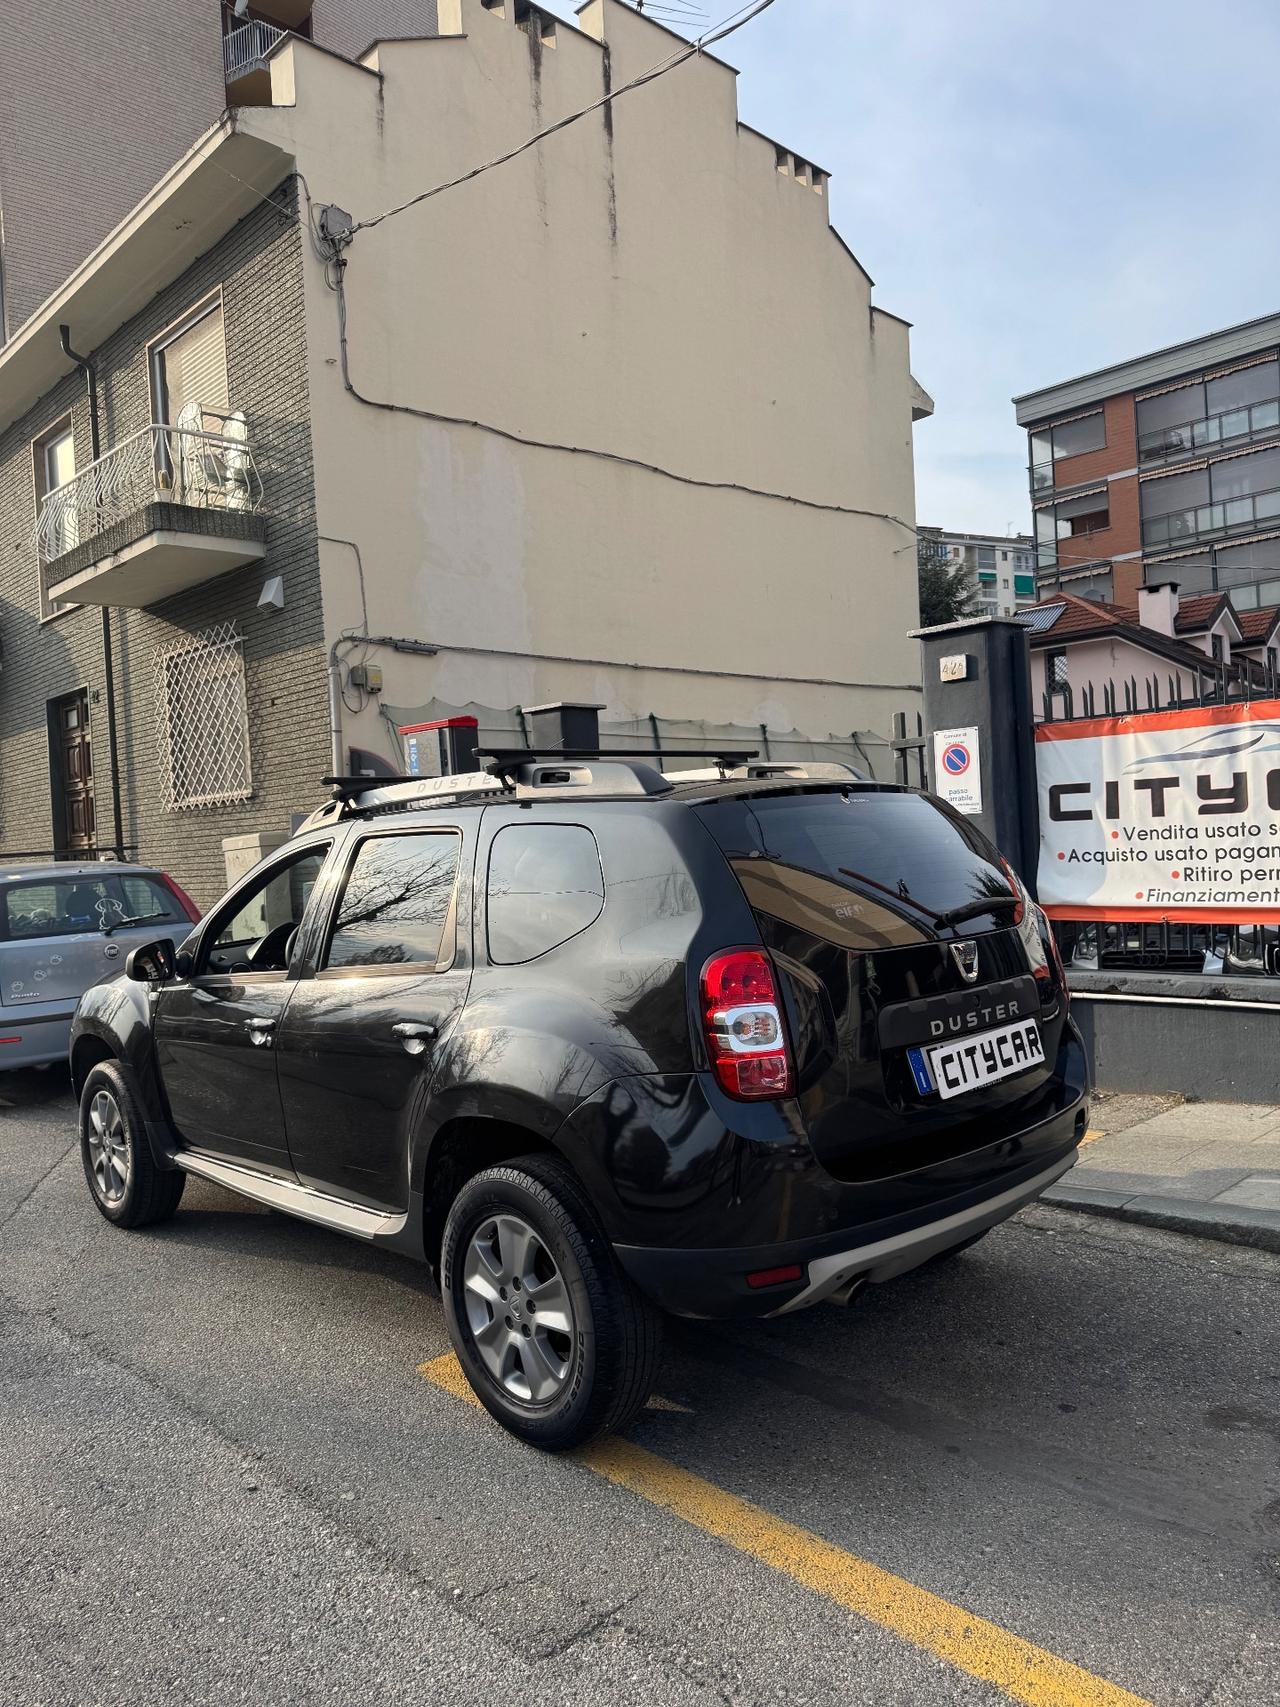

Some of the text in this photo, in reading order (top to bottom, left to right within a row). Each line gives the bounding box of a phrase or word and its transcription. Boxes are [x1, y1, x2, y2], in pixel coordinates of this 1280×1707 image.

[417, 775, 491, 794] DUSTE
[1123, 821, 1280, 841] Vendita usato s
[1067, 847, 1148, 866] Acquisto
[1155, 845, 1208, 861] usato
[1183, 866, 1233, 882] Ritiro
[929, 1000, 1020, 1036] DUSTER
[940, 1025, 1042, 1089] CITYCAR
